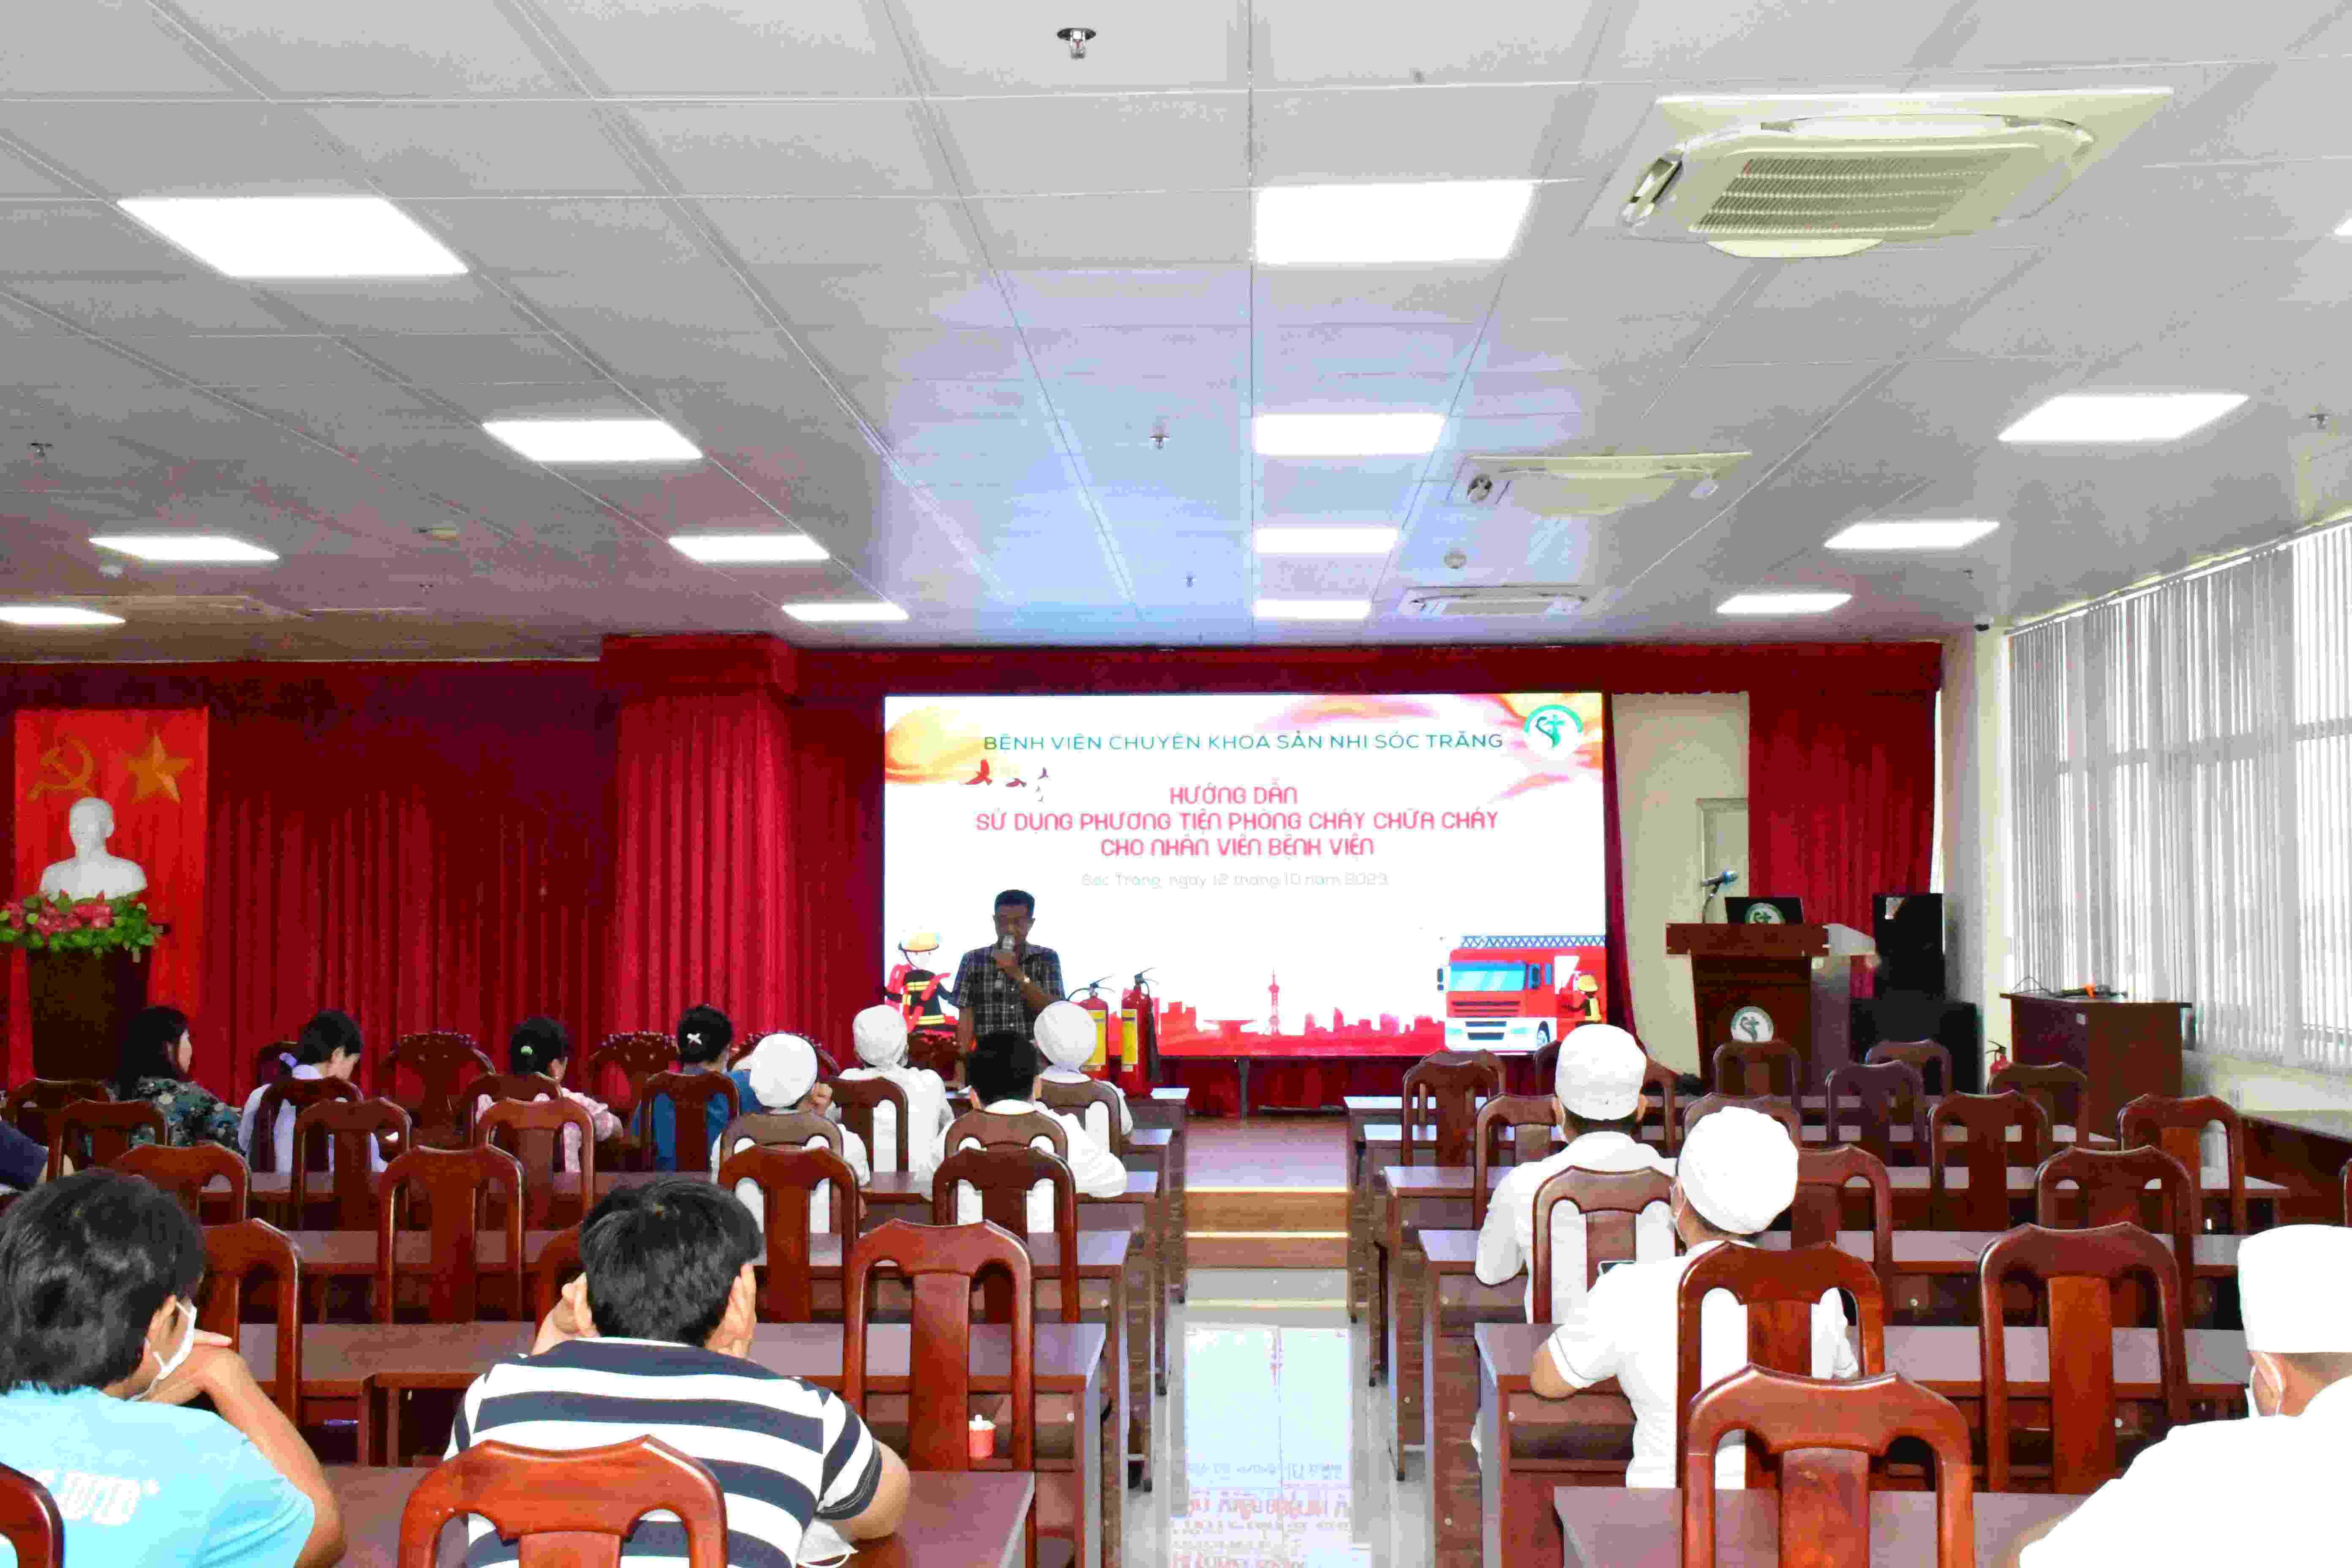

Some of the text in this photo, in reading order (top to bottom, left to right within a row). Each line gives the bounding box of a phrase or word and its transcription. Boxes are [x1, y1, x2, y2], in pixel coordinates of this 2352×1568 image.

[984, 733, 1044, 753] BỆNH
[1051, 733, 1102, 753] VIỆN
[1109, 732, 1200, 750] CHUYÊN
[1209, 734, 1270, 750] KHOA
[1331, 734, 1368, 750] NHI
[1375, 730, 1420, 749] SÓC
[1014, 812, 1073, 835] DỤNG
[1309, 807, 1365, 830] CHÁY
[1441, 806, 1498, 830] CHÁY
[1101, 838, 1144, 857] CHO
